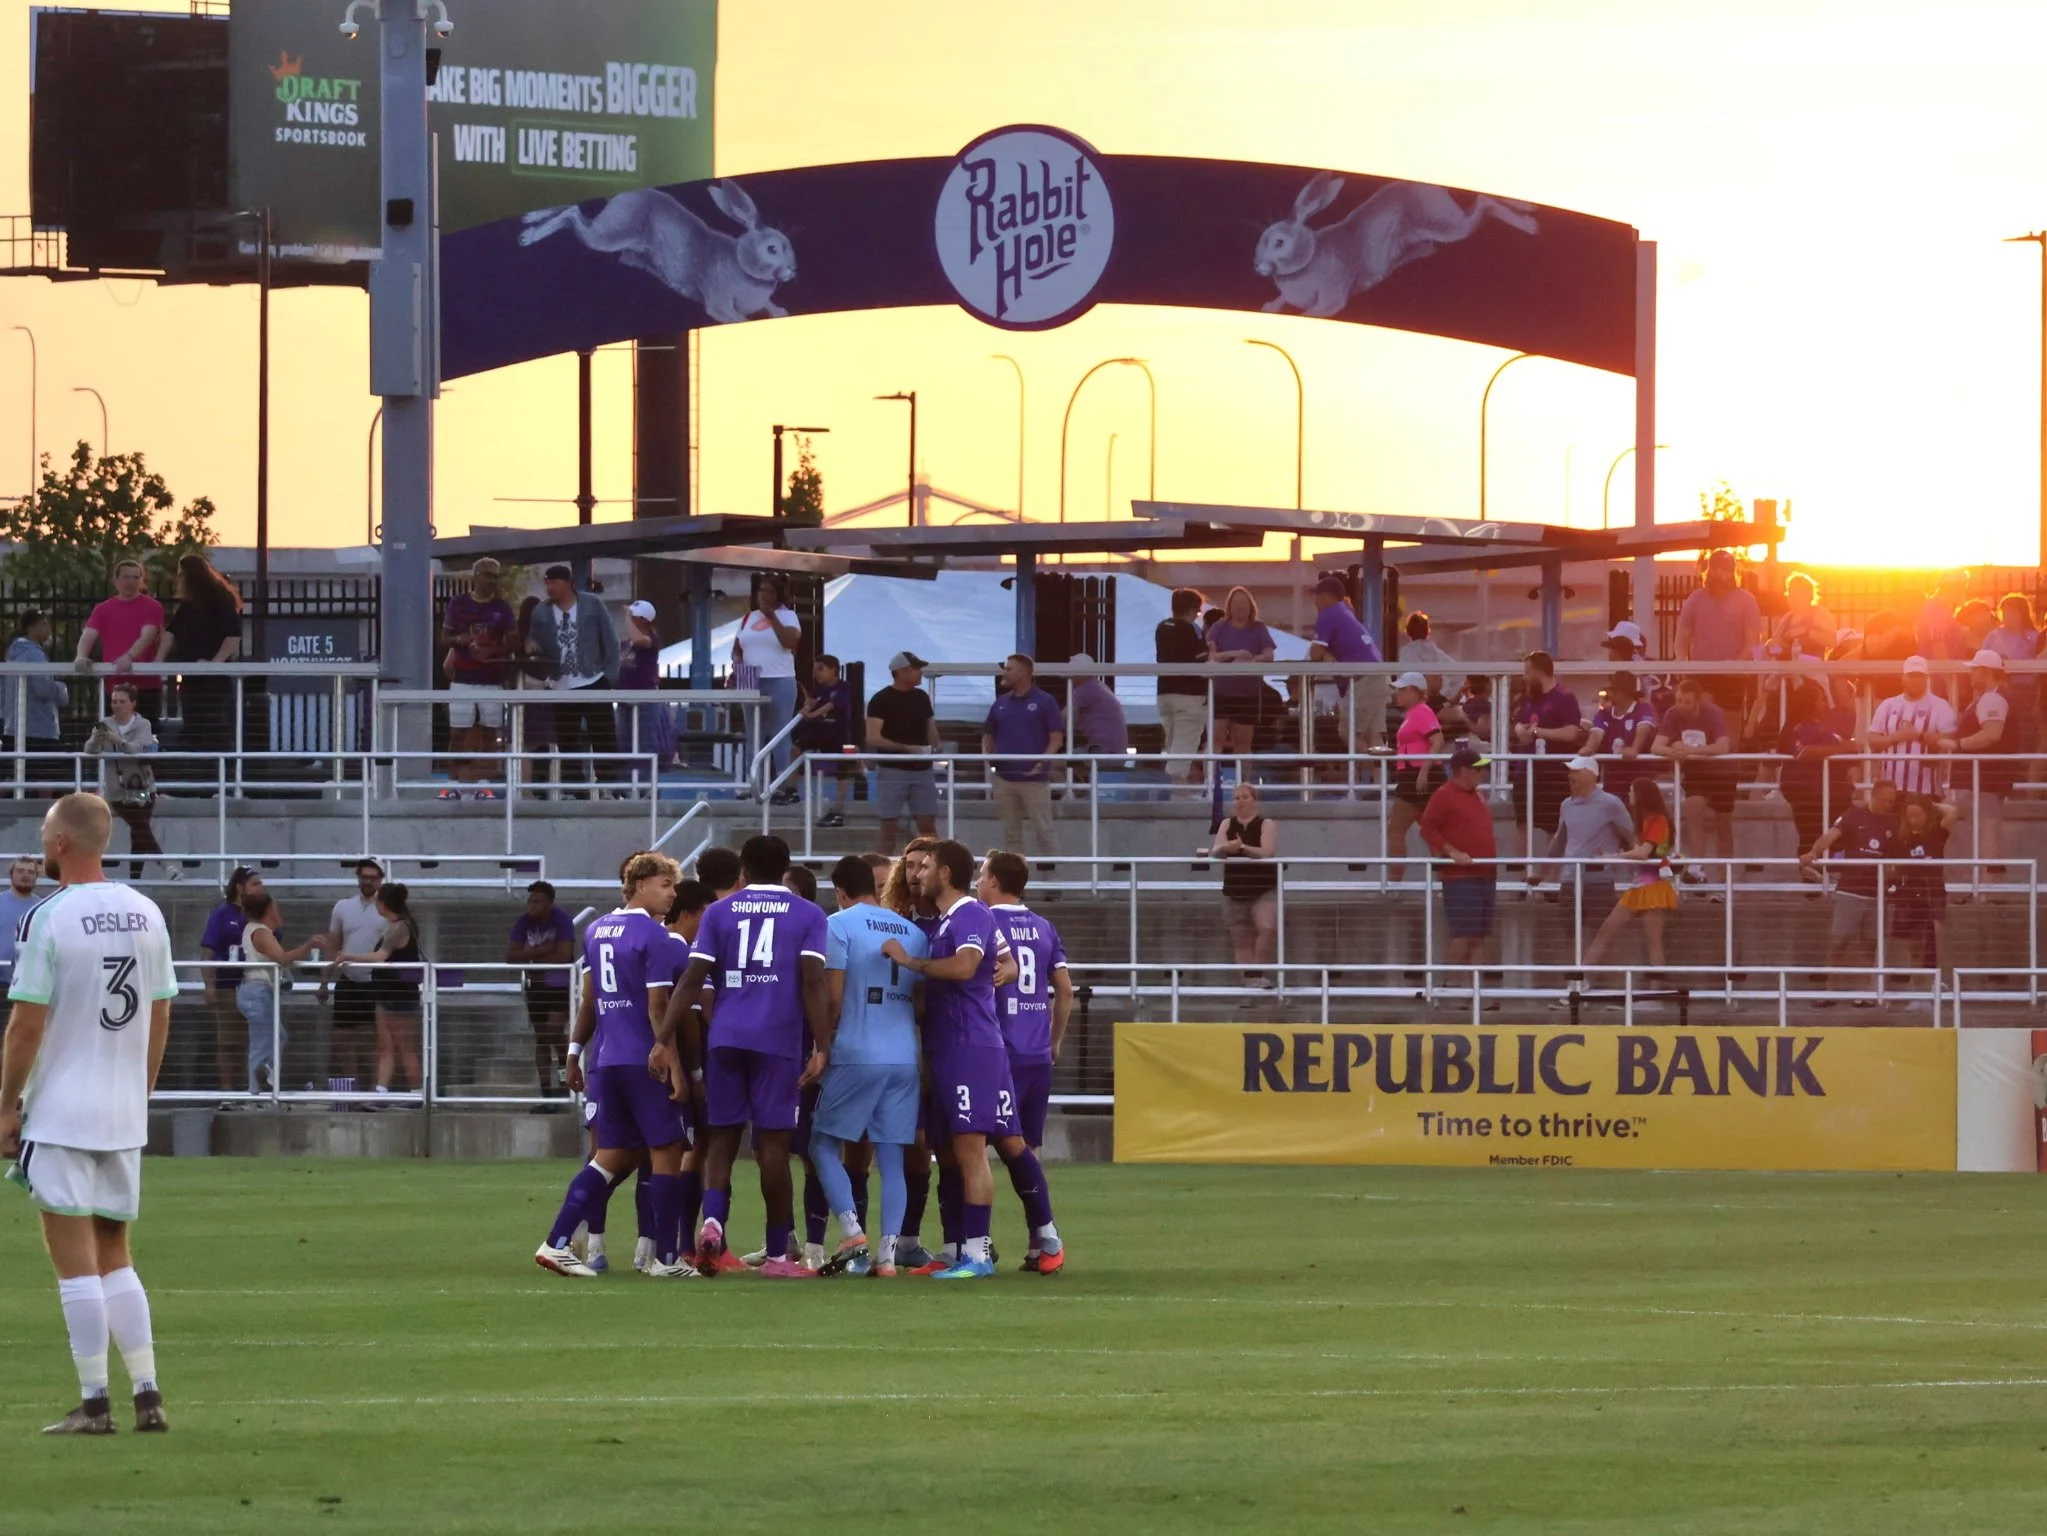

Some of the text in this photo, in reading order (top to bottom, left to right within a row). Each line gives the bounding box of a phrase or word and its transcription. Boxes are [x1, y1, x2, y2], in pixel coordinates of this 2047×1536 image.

[275, 75, 361, 104] DRAFT
[425, 61, 698, 119] AKE BIG MOMENTS BIGGER
[286, 98, 358, 126] KINGS
[275, 127, 366, 147] SPORTSBOOK
[454, 123, 637, 172] WITH LIVE BETTING
[961, 155, 1090, 265] Rabbit
[288, 635, 334, 654] GATE 5
[731, 901, 790, 914] SHOWUNMI
[81, 912, 149, 936] DESLER
[594, 925, 625, 939] DUNCAN
[865, 919, 910, 936] FAUROUX
[737, 917, 775, 969] 14
[599, 943, 618, 993] 6
[744, 974, 779, 983] TOYOTA
[1017, 945, 1036, 995] 8
[99, 955, 139, 1031] 3
[1019, 1002, 1047, 1011] TOYOTA
[1242, 1032, 1827, 1098] REPUBLIC BANK
[956, 1084, 971, 1111] 3
[1417, 1111, 1492, 1138] Time
[1500, 1113, 1532, 1138] to
[1489, 1154, 1573, 1167] Member FDIC
